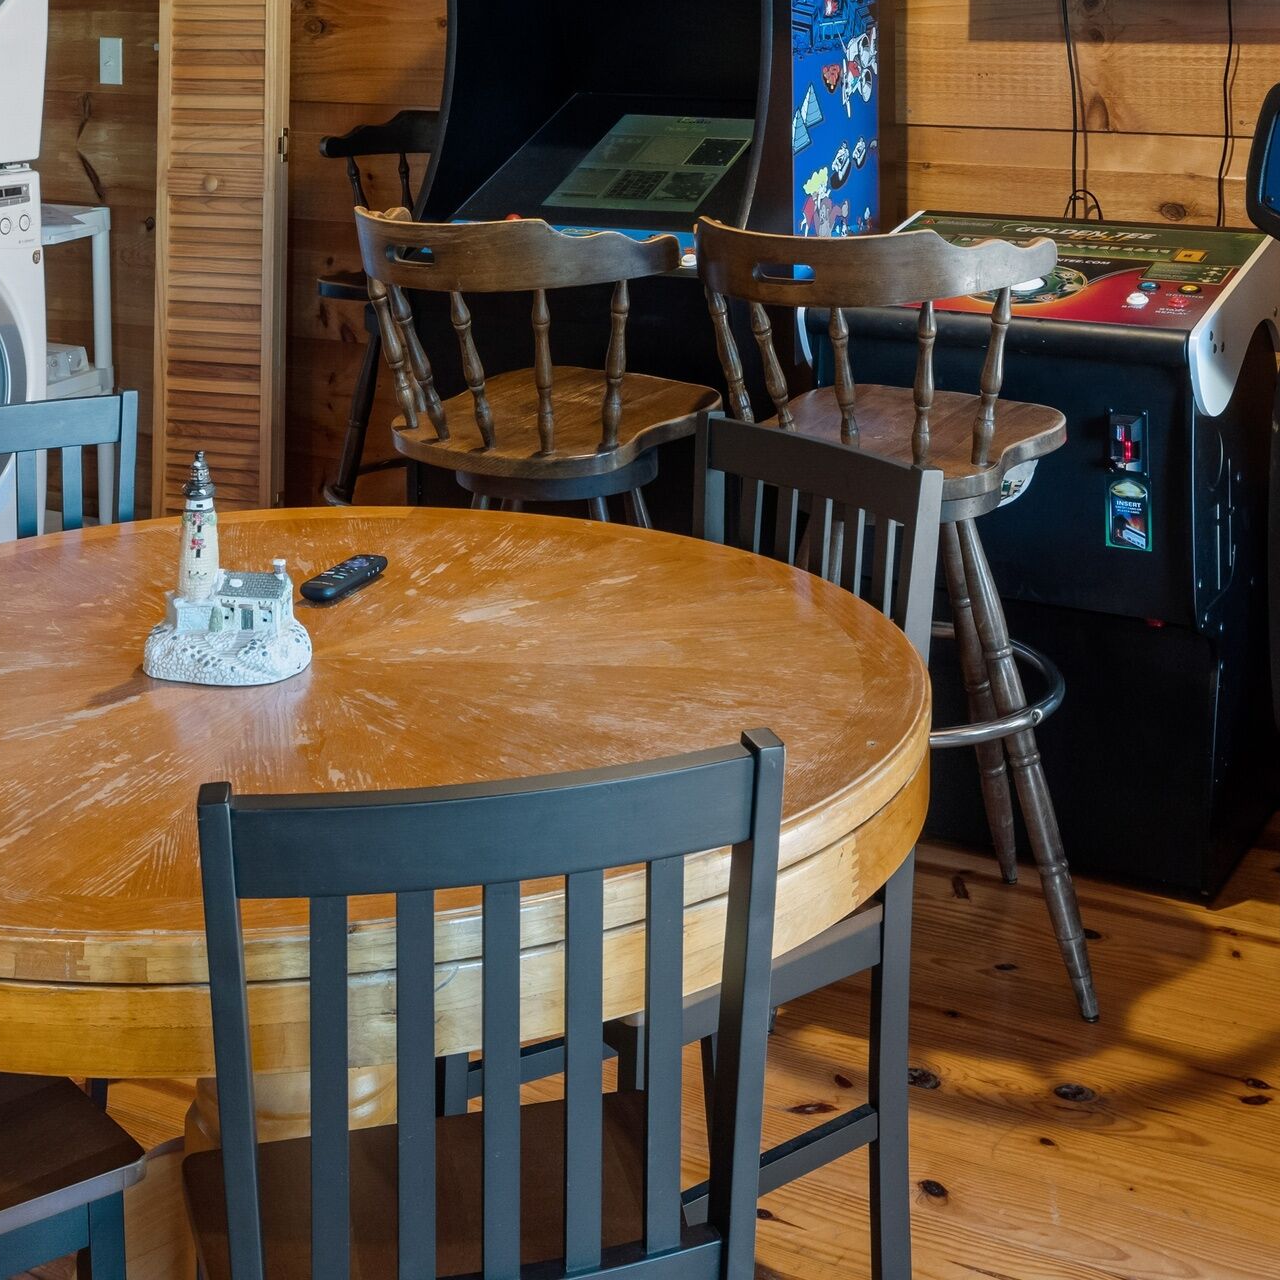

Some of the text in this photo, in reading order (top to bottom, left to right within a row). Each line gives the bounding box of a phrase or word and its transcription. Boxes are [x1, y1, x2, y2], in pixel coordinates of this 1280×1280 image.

[1015, 225, 1157, 241] GOLDEN TEE
[1116, 500, 1142, 508] INSERT
